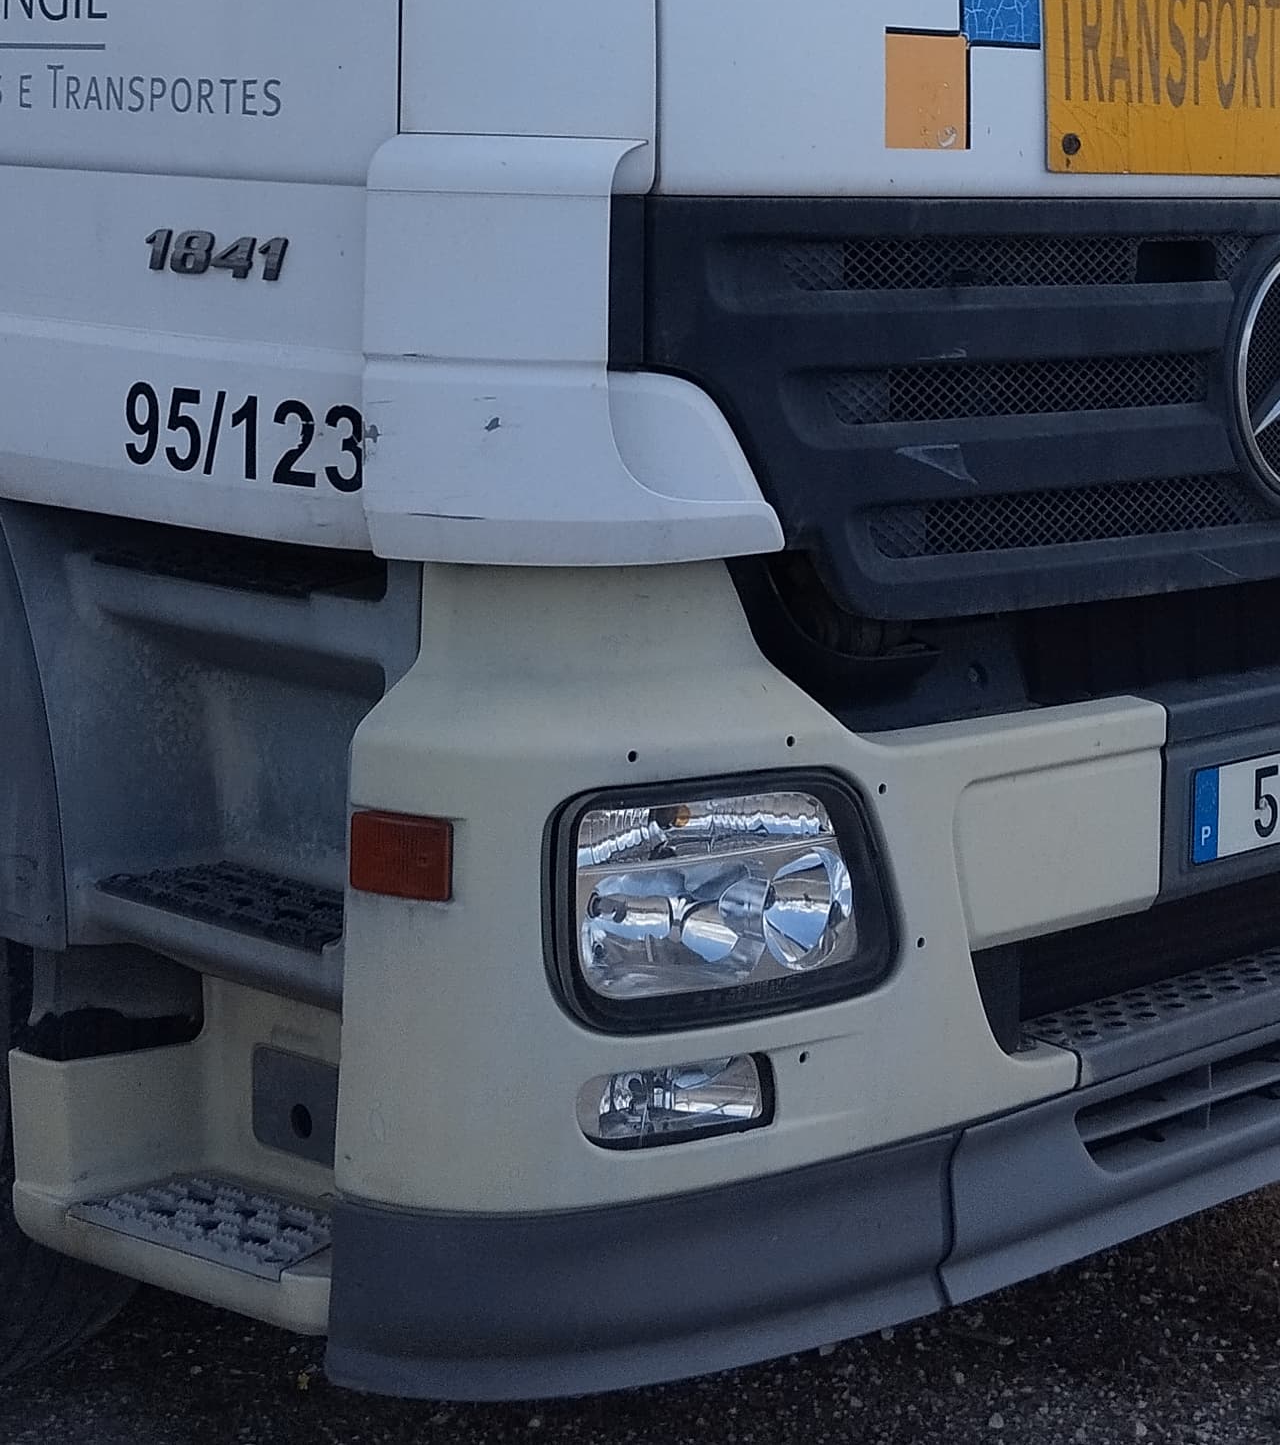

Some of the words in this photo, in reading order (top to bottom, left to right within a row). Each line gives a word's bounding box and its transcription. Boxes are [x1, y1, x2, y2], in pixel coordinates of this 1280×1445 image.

[19, 74, 33, 109] E
[46, 64, 283, 117] TRANSPORTES
[145, 229, 289, 281] 1841
[125, 381, 364, 493] 95/123
[1201, 825, 1212, 846] P
